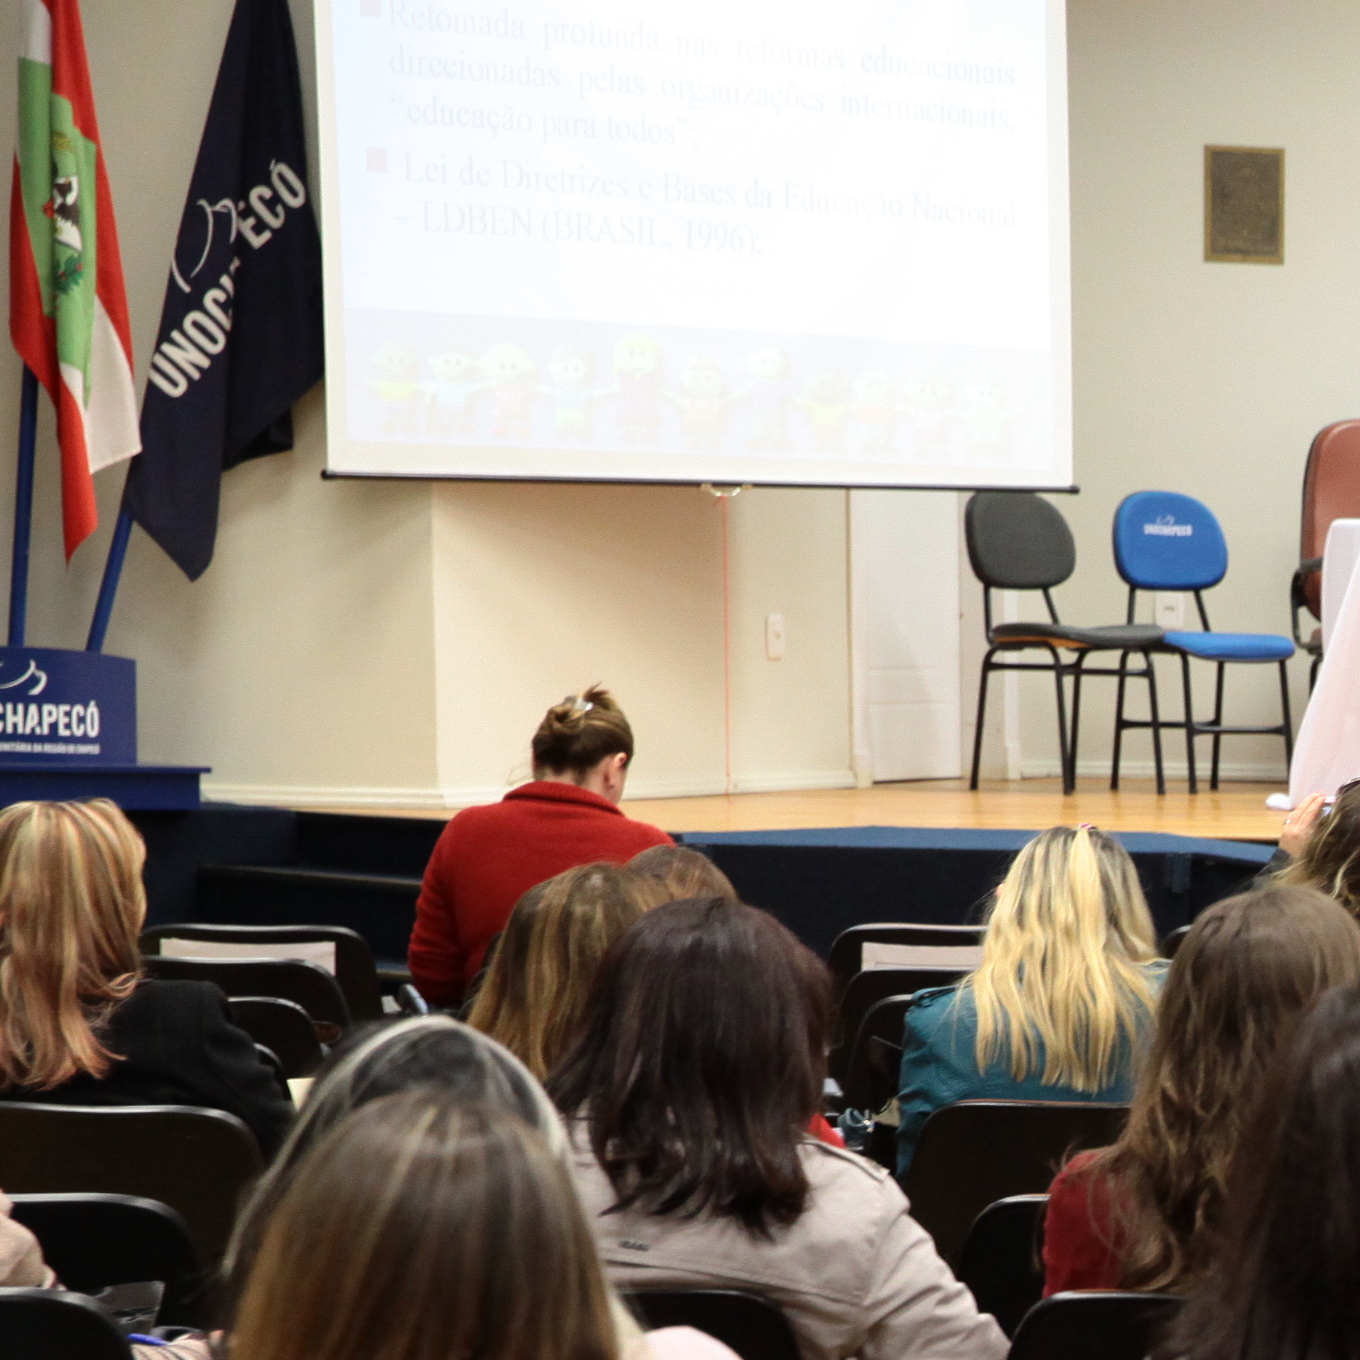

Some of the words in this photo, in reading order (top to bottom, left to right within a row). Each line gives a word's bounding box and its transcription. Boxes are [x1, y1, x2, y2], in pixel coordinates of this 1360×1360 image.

[388, 0, 527, 41] Retomada
[543, 16, 660, 51] profunda
[676, 34, 720, 58] nas
[736, 33, 846, 70] reformas
[860, 44, 1017, 88] educacionais
[388, 43, 561, 89] direcionadas
[579, 62, 646, 101] pelas
[660, 76, 826, 116] organizações
[542, 111, 598, 146] para
[403, 150, 449, 186] Lei
[458, 154, 491, 189] de
[501, 157, 629, 200] Diretrizes
[636, 175, 654, 201] e
[662, 169, 738, 208] Bases
[744, 176, 774, 211] da
[783, 179, 905, 224] Educação
[911, 190, 1017, 230] Nacional
[421, 200, 534, 238] LDBEN
[541, 205, 675, 253] (BRASIL,
